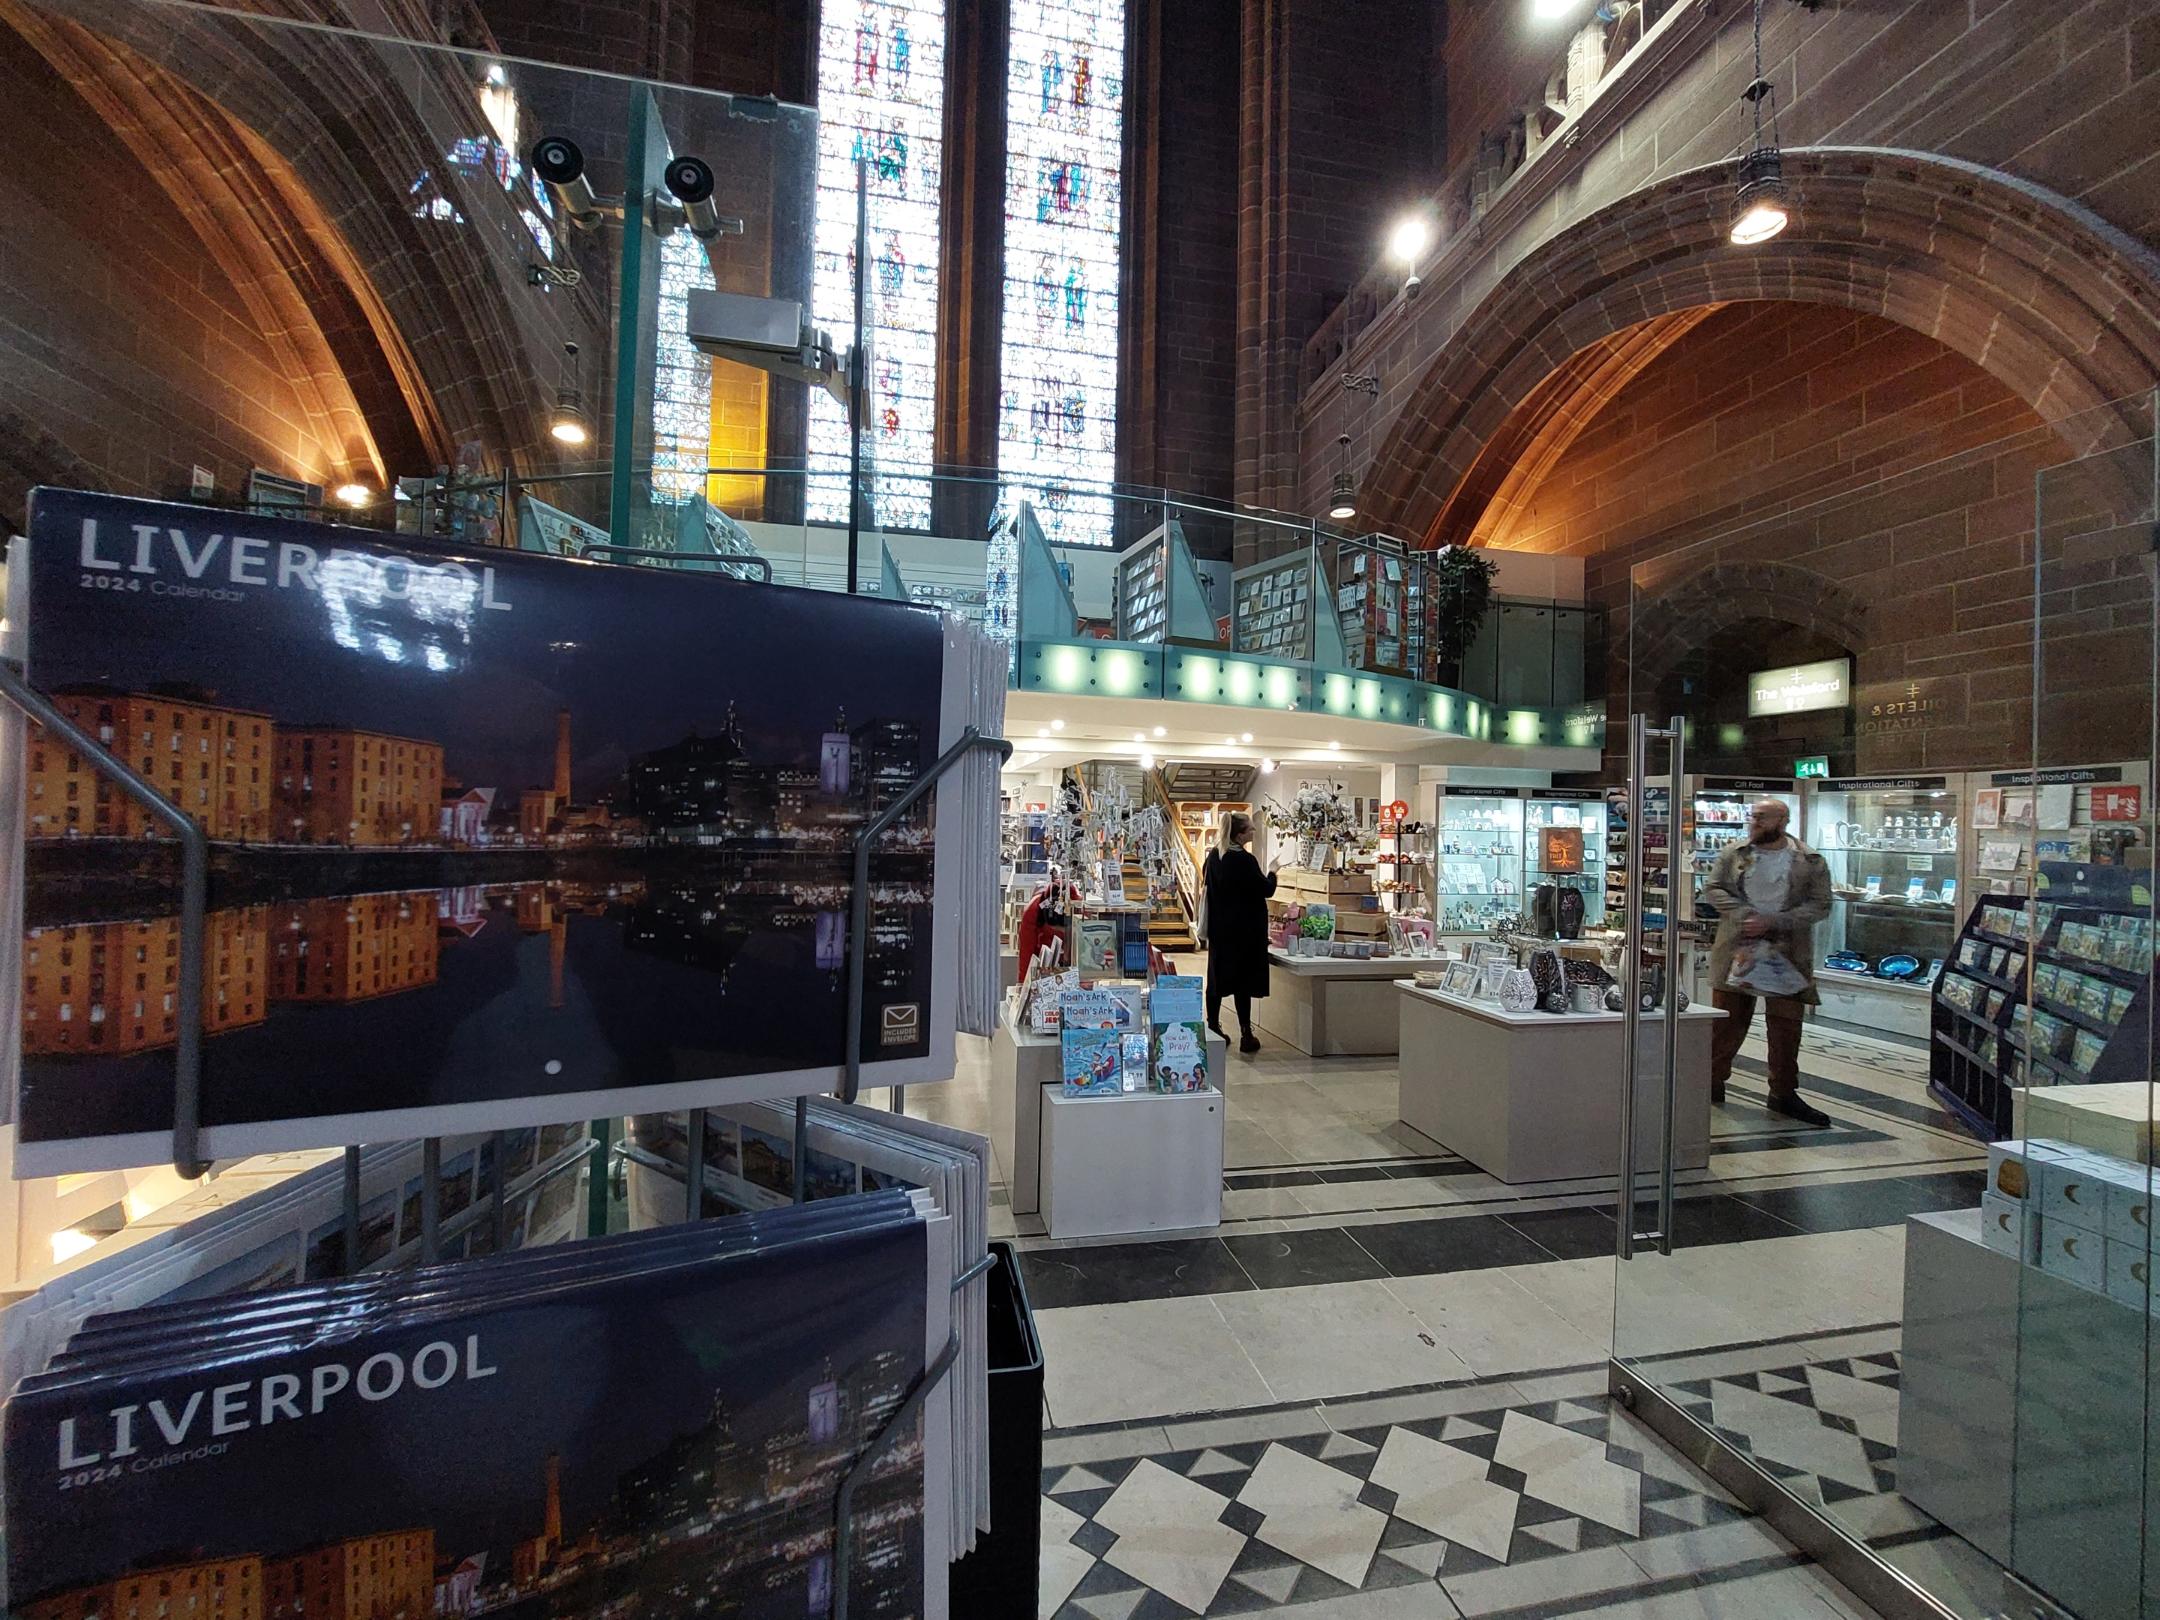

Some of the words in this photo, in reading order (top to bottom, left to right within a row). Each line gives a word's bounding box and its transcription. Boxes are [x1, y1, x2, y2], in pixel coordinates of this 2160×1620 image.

[80, 517, 512, 611] LIVEROL
[80, 573, 141, 593] 2024
[150, 579, 246, 603] Calendar
[1756, 688, 1778, 702] The
[2071, 770, 2096, 781] Gifts
[1838, 781, 1895, 791] Inspirational
[1897, 779, 1920, 789] Gifts
[1458, 787, 1491, 796] Inspirational
[1060, 992, 1090, 1001] Noah's
[1092, 992, 1107, 1001] Ark
[1066, 1006, 1097, 1016] Noah's
[1098, 1006, 1114, 1016] Ark
[1169, 1041, 1190, 1053] Pray?
[58, 1334, 498, 1471] LIVERPOOL
[58, 1464, 122, 1491] 2024
[131, 1439, 234, 1474] Calendar
